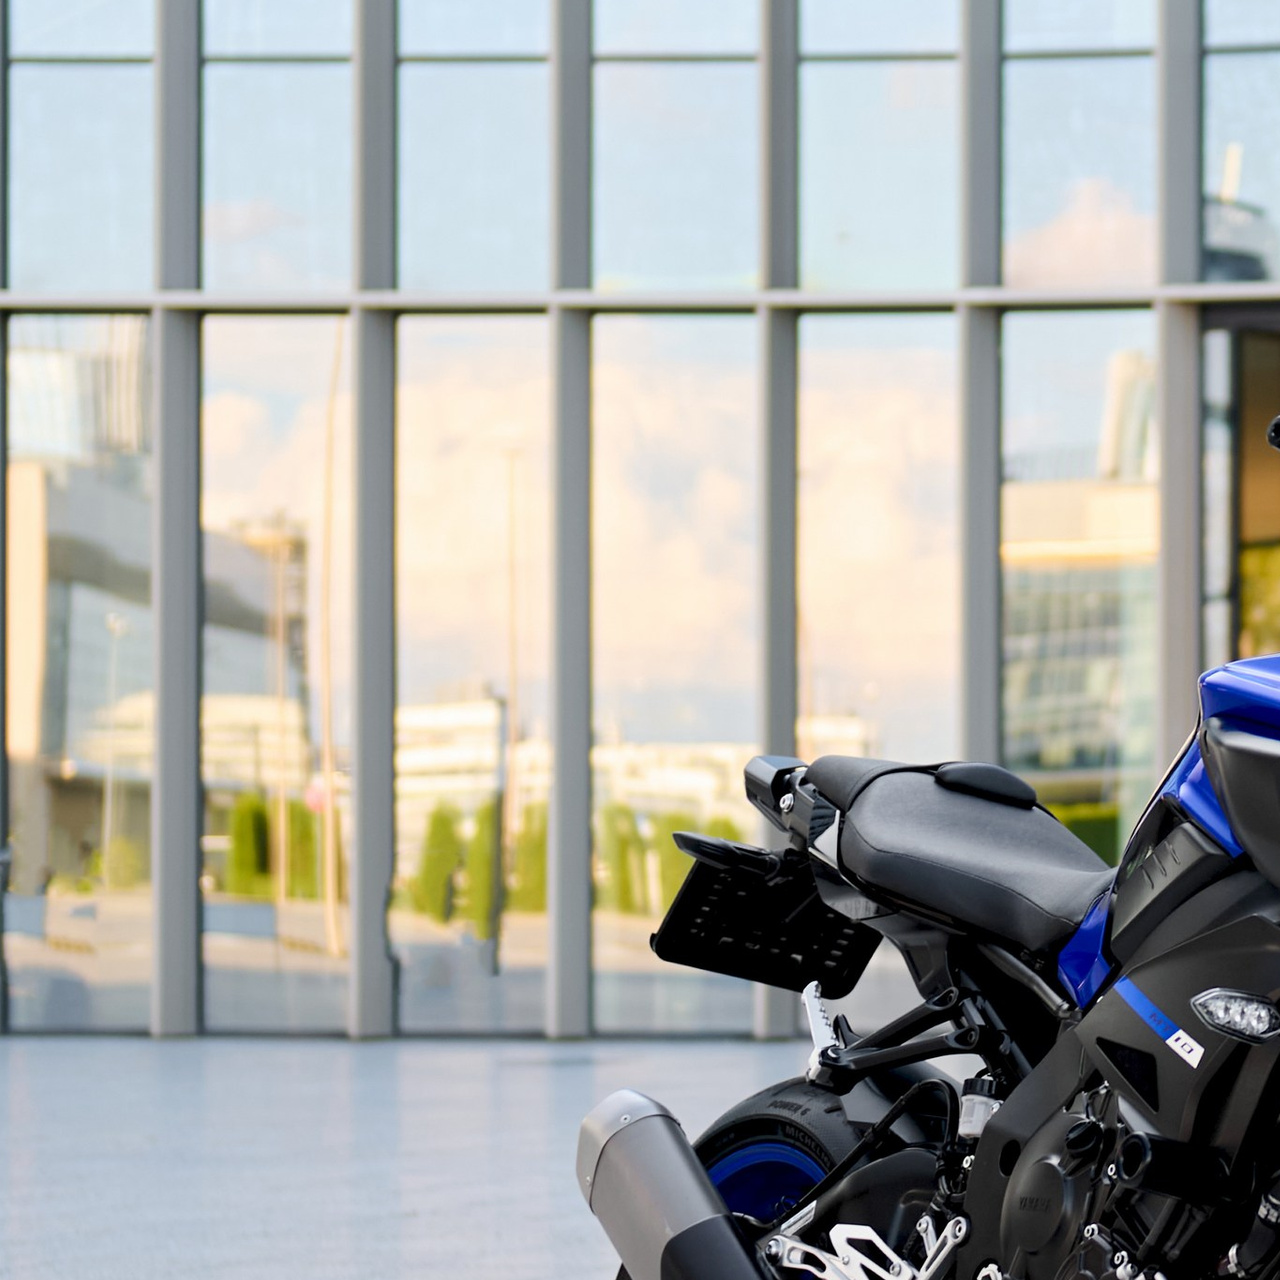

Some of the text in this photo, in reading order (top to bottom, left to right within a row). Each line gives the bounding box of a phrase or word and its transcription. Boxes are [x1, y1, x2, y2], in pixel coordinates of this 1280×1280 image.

[1174, 1036, 1194, 1054] 10
[768, 1100, 804, 1115] POWER
[785, 1124, 831, 1168] MICHELIN
[1019, 1196, 1052, 1213] YAMAHA
